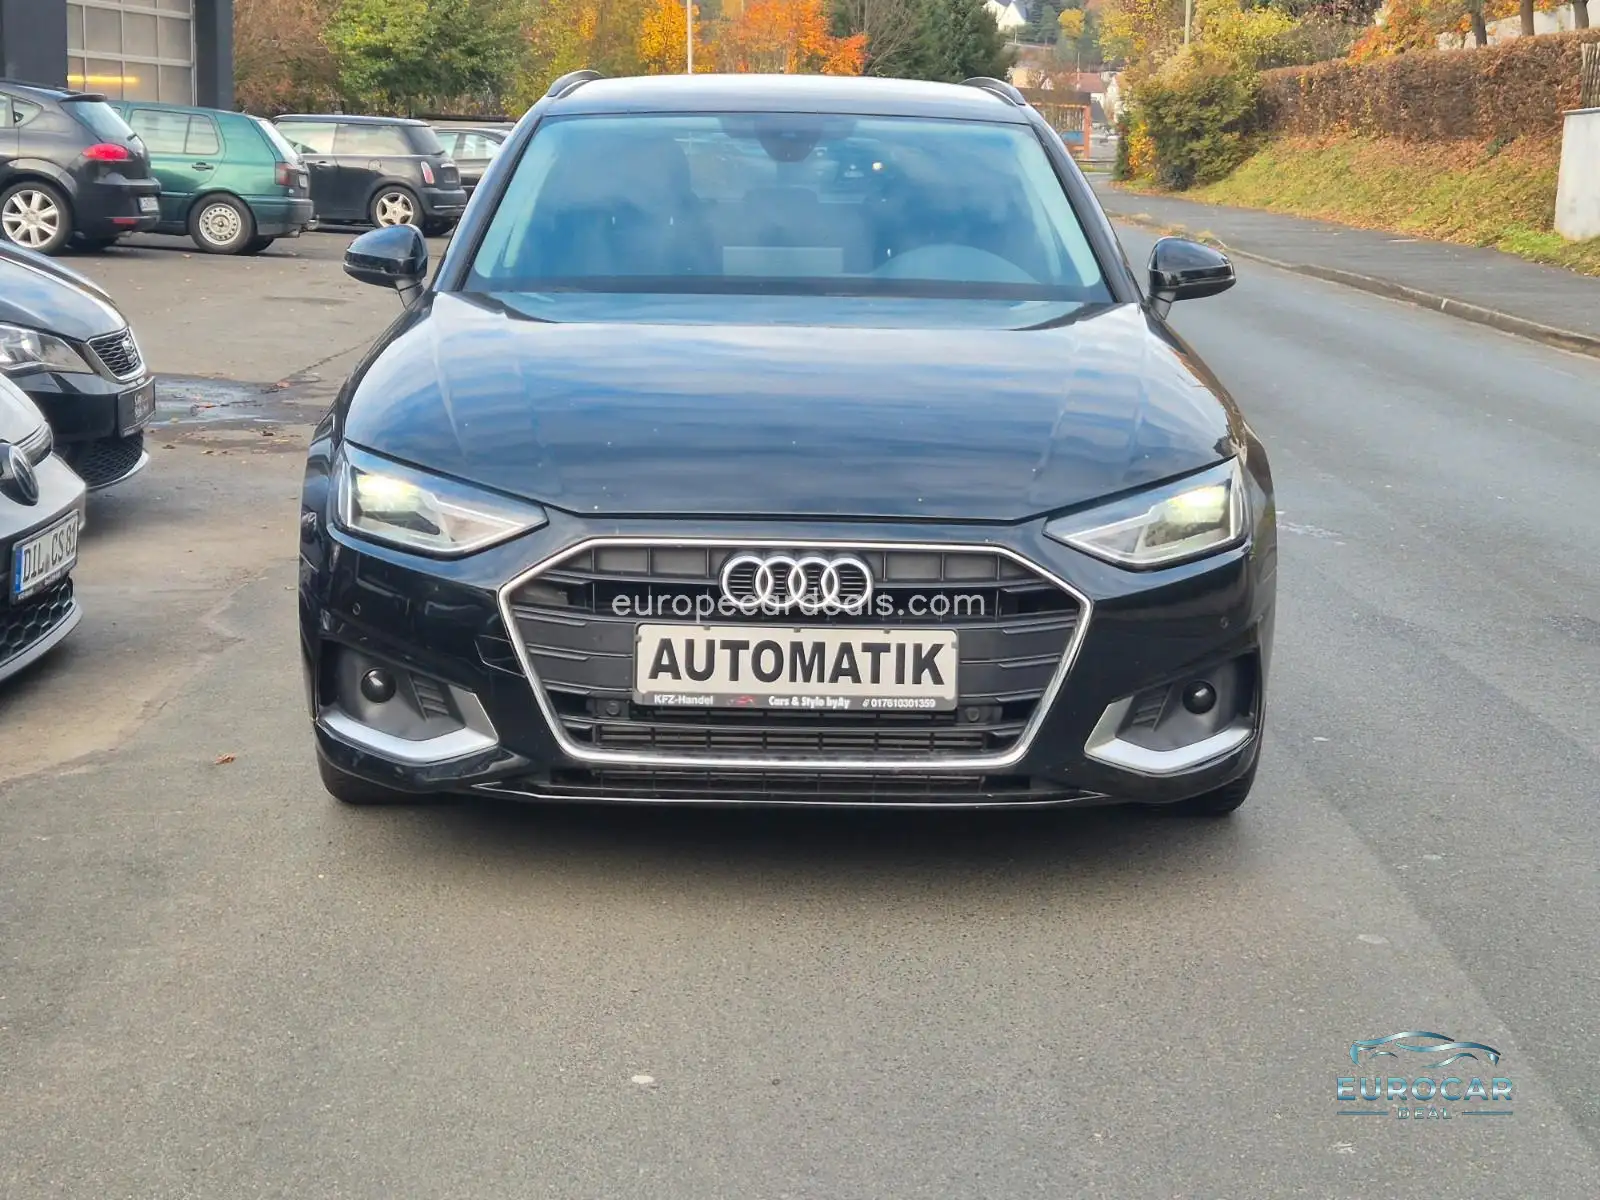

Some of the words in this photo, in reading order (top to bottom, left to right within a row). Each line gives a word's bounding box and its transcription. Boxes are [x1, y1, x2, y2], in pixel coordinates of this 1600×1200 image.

[23, 541, 44, 581] DIL
[52, 529, 64, 566] CS
[648, 638, 946, 686] AUTOMATIK
[653, 694, 714, 706] KFZ-Handel
[768, 695, 790, 706] Cars
